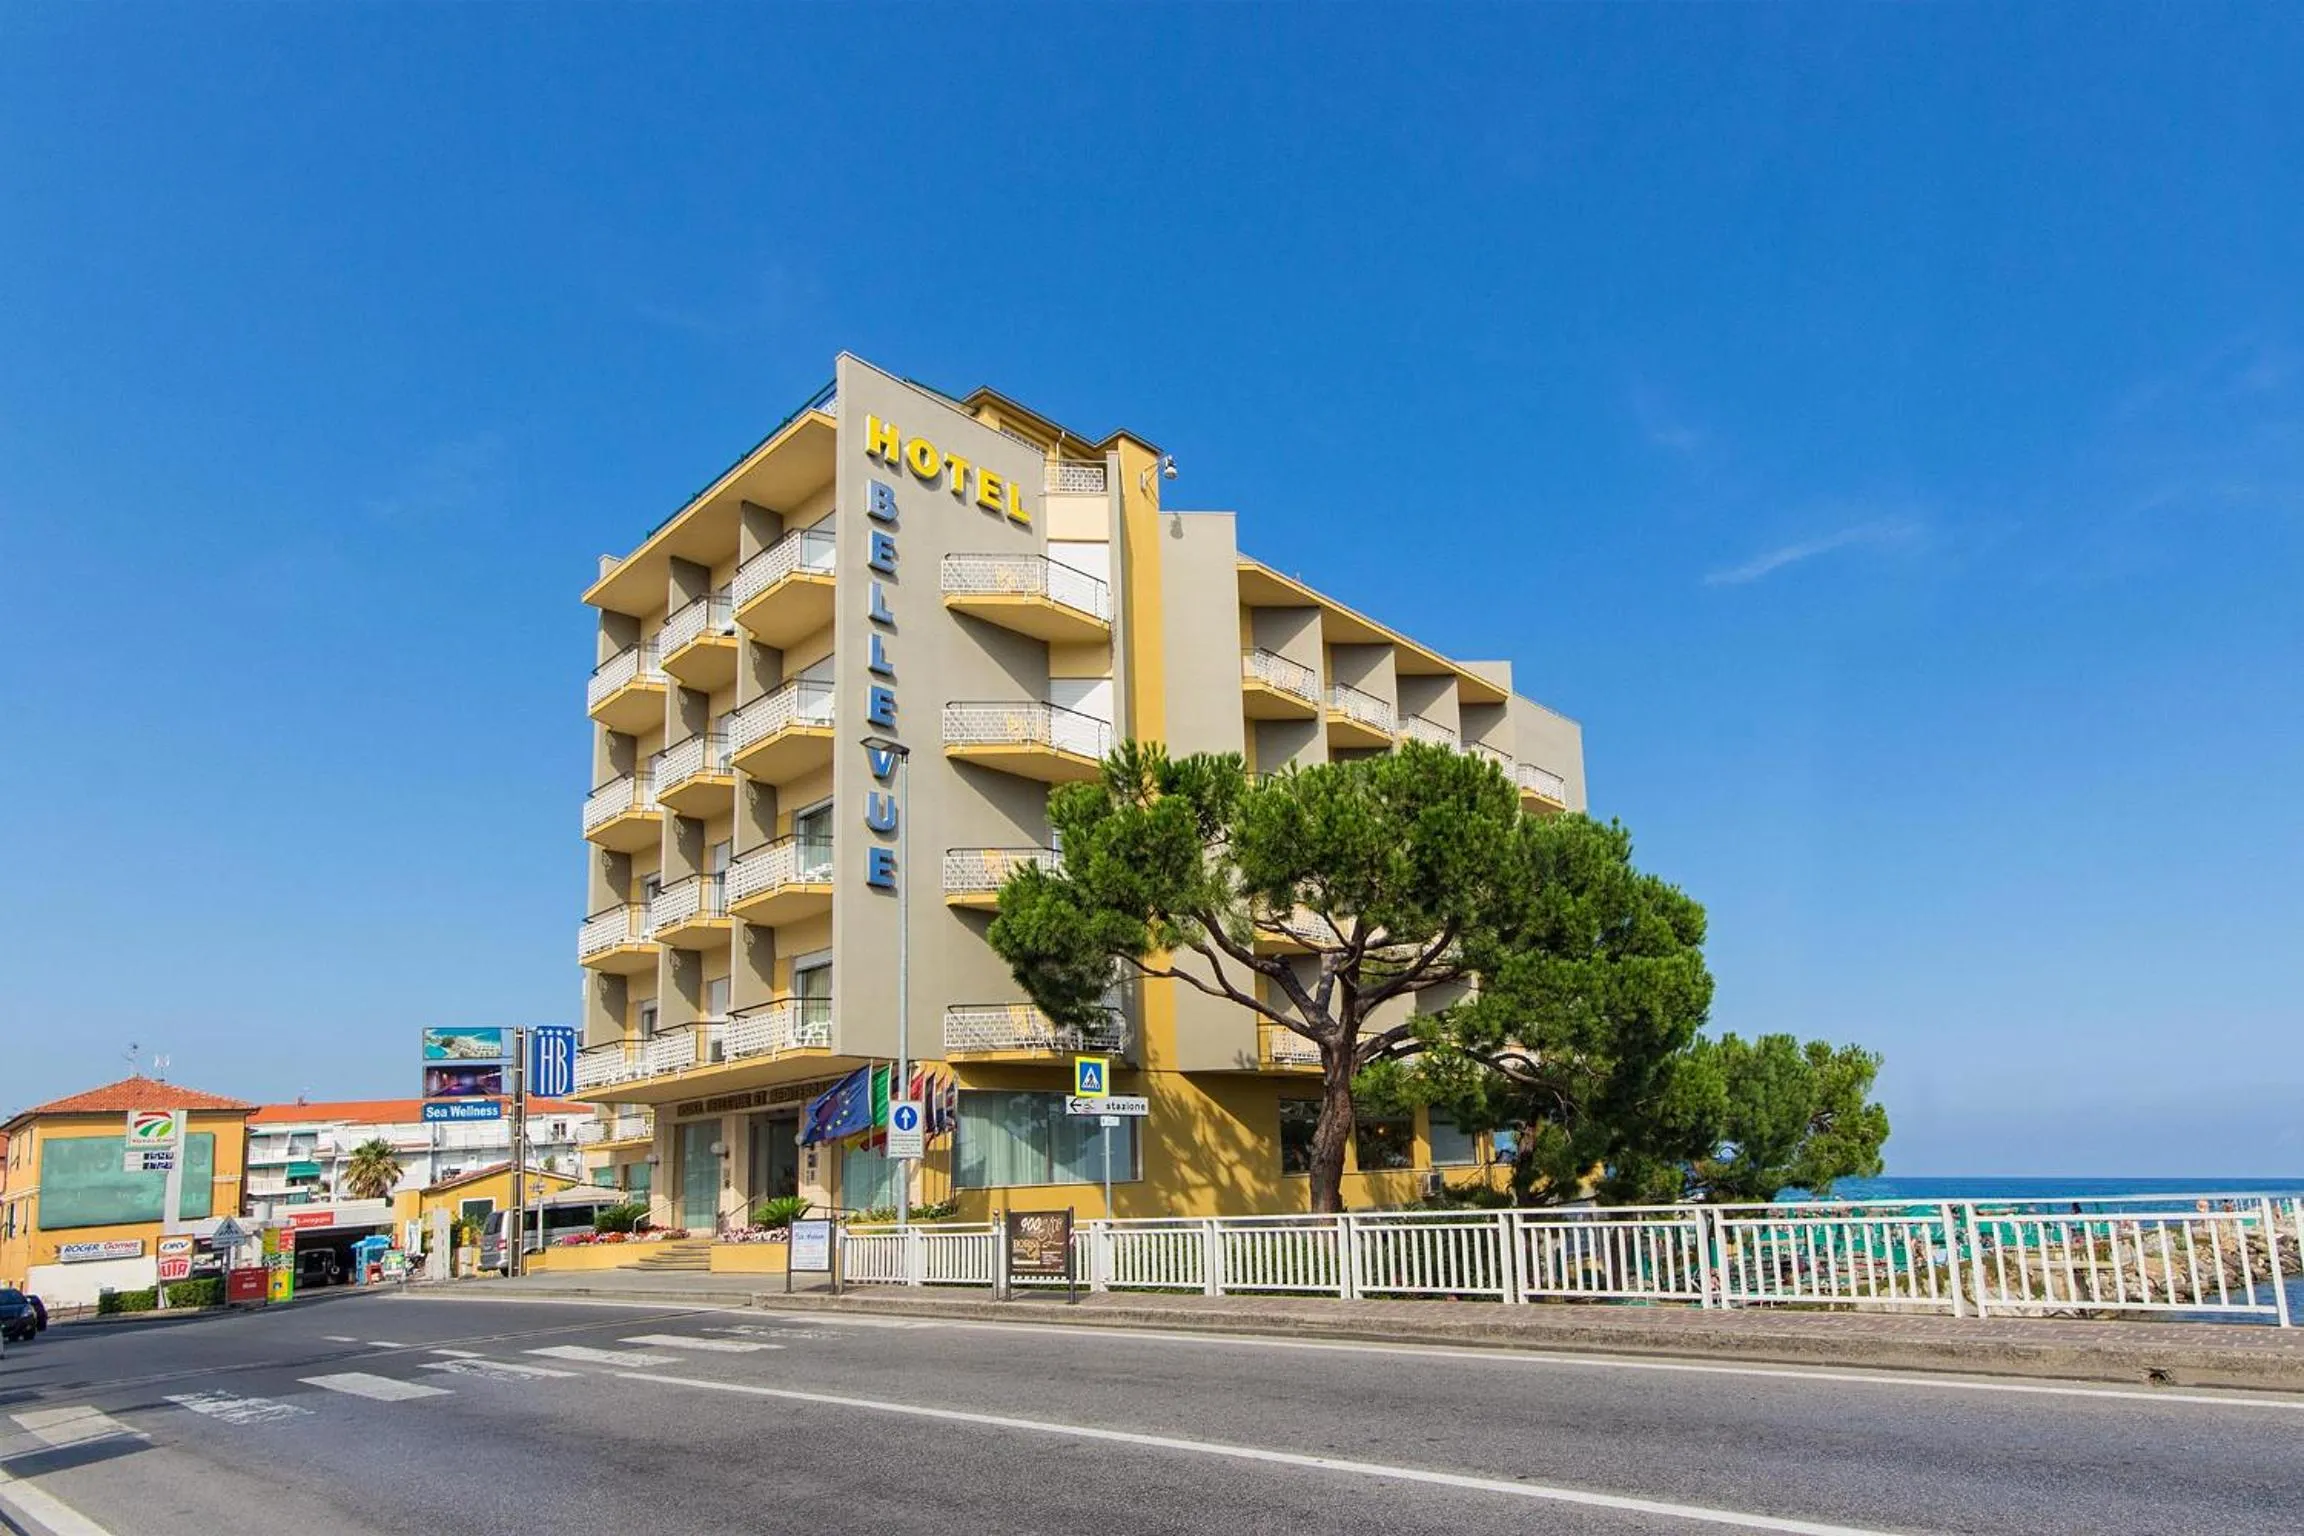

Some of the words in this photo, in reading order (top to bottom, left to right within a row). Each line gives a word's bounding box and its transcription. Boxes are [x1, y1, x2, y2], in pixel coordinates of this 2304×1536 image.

[866, 413, 1032, 525] HOTEL
[866, 478, 899, 889] BELLEVUE
[540, 1036, 568, 1094] HB
[426, 1106, 448, 1118] Sea
[450, 1105, 498, 1117] Wellness
[1106, 1101, 1146, 1111] stazione
[64, 1243, 100, 1253] ROGER
